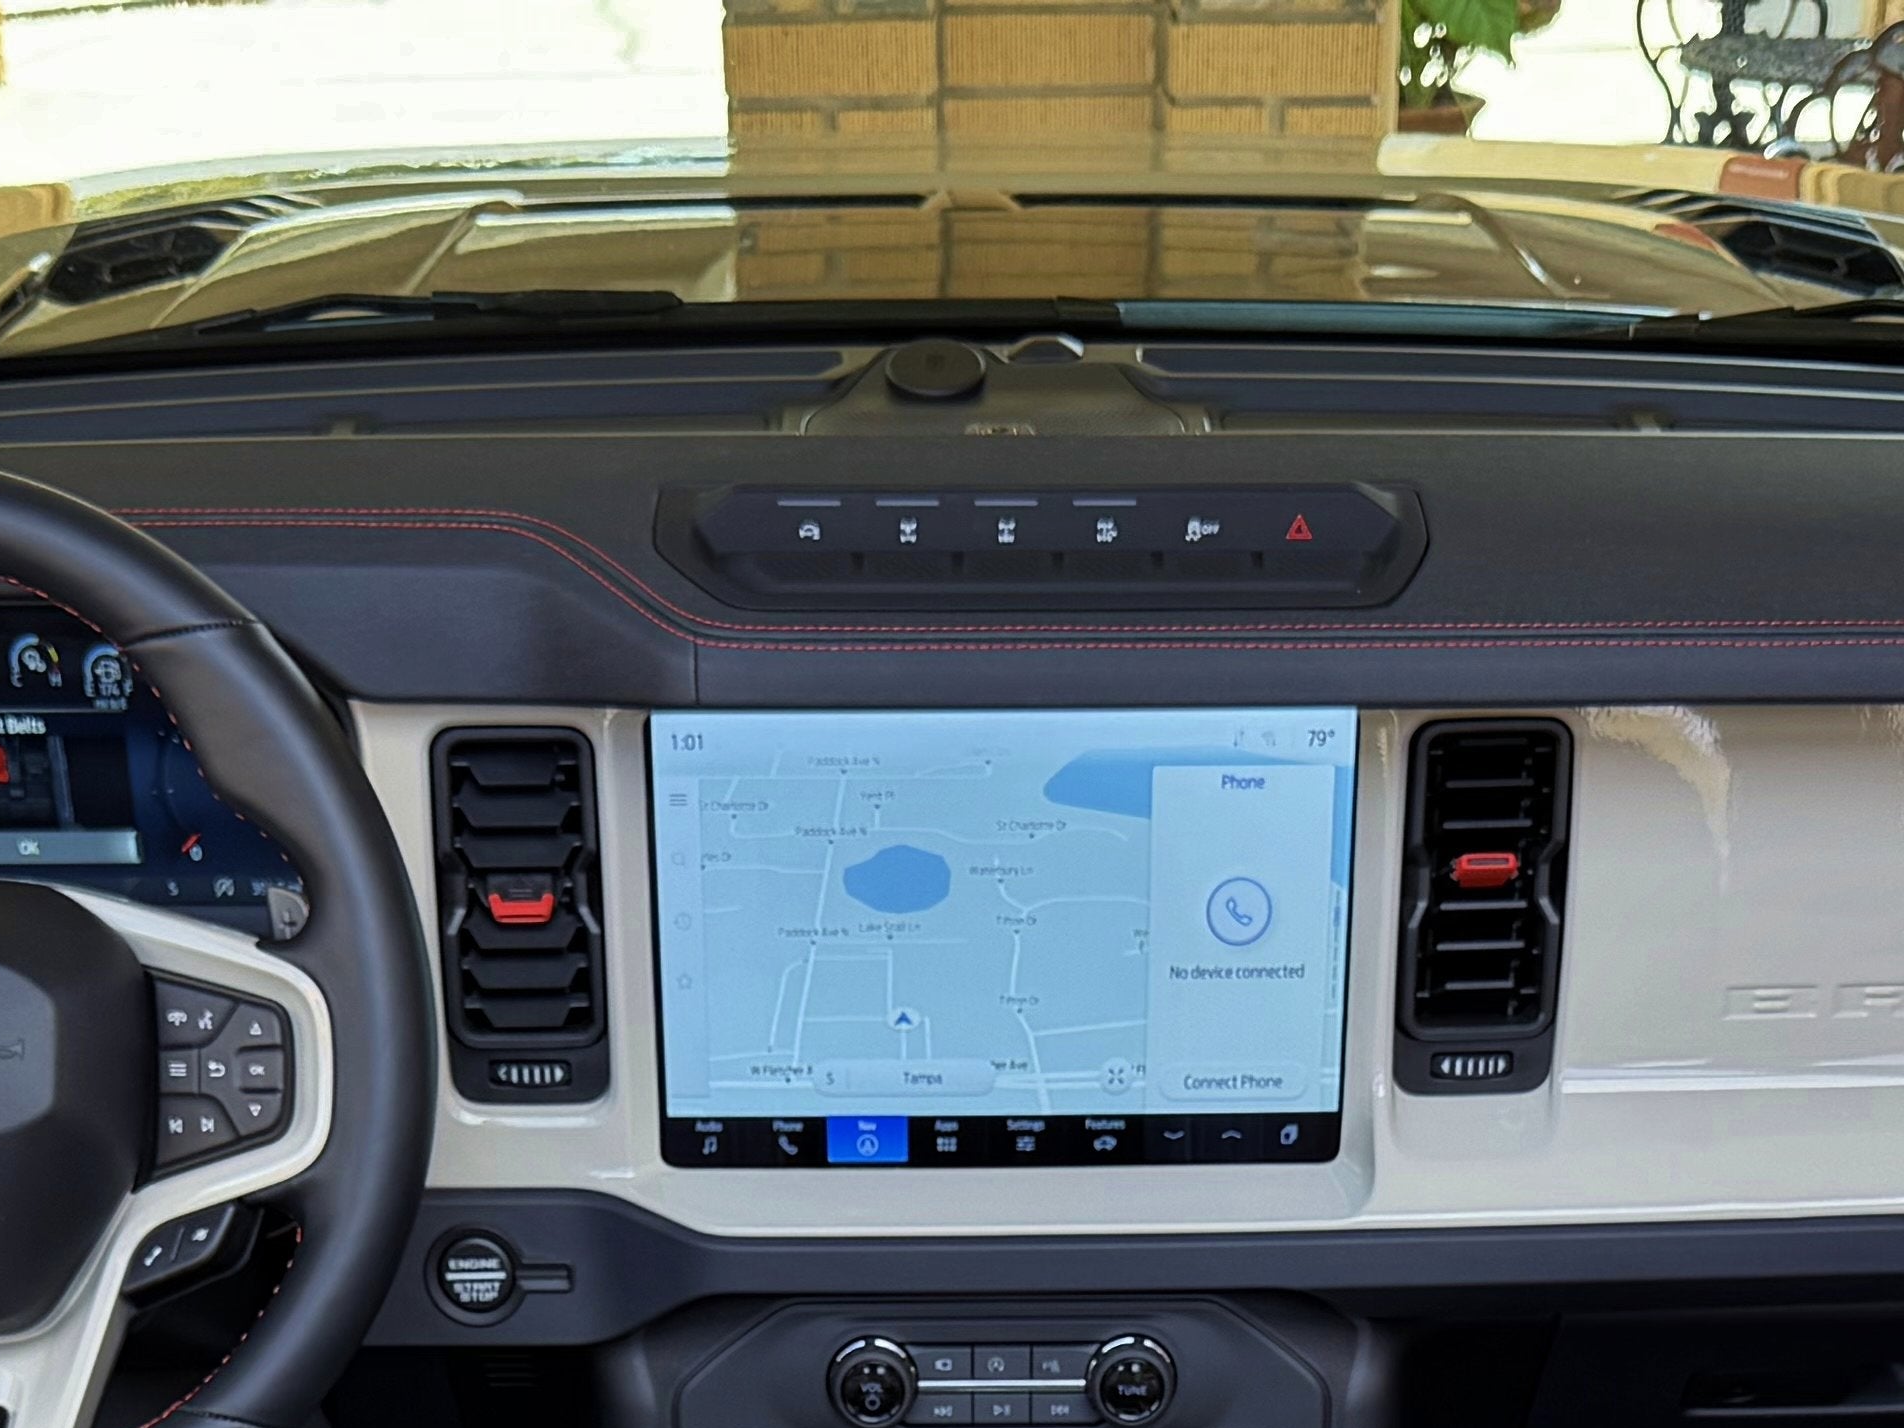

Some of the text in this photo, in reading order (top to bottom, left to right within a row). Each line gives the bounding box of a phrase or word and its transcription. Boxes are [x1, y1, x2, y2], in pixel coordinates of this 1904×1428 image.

[4, 714, 46, 735] Belts
[670, 733, 705, 751] 1:01
[1307, 728, 1336, 747] 79°
[1221, 774, 1266, 790] Phone
[1169, 964, 1306, 980] No device connected
[903, 1071, 944, 1087] Tampa
[1183, 1074, 1283, 1090] Connect Phone
[1116, 1384, 1148, 1397] TUNE
